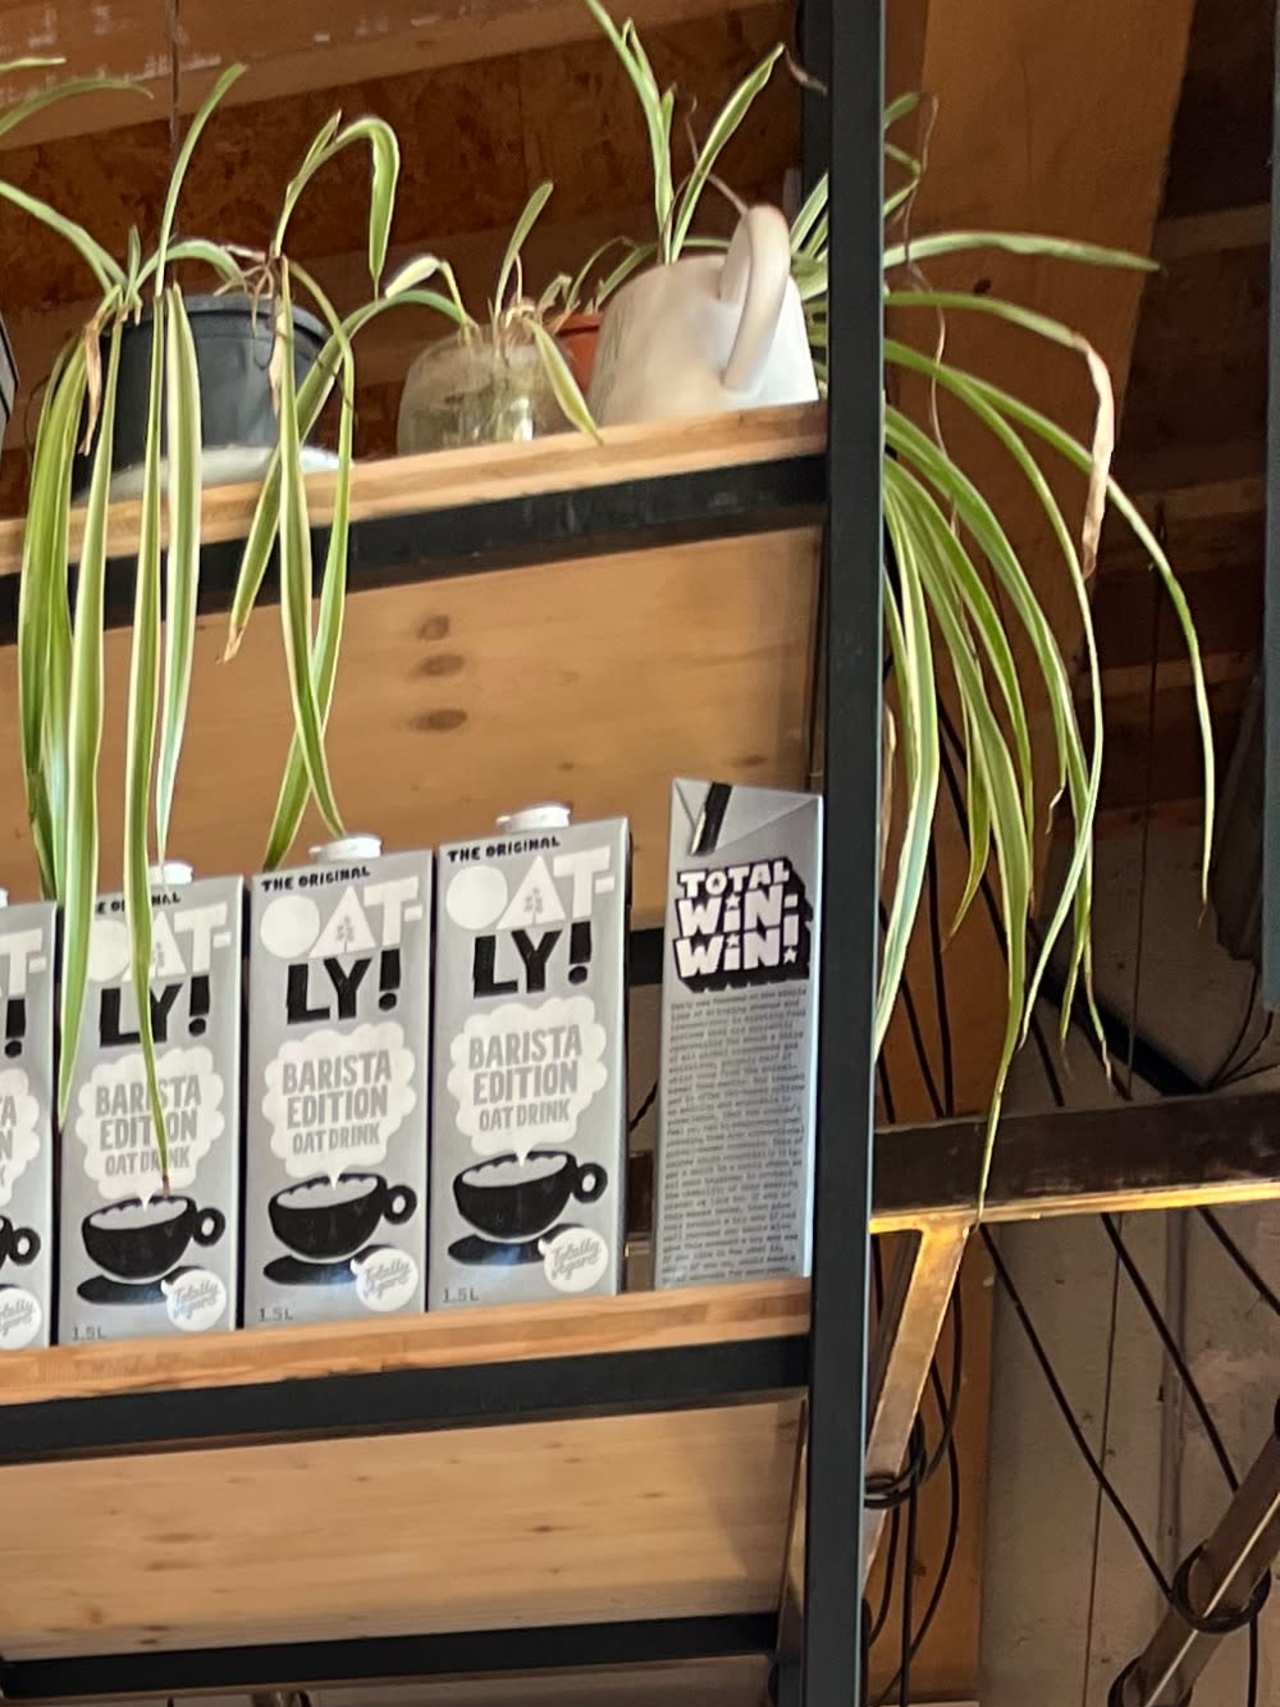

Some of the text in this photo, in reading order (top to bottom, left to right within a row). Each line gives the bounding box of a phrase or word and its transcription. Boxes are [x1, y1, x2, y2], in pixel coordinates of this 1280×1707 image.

[448, 847, 482, 865] THE
[261, 877, 292, 893] THE
[678, 859, 790, 899] TOTAL
[472, 920, 592, 999] LY!
[286, 948, 402, 1025] LY!
[99, 975, 211, 1048] LY!
[468, 1024, 583, 1070] BARISTA
[282, 1050, 393, 1095] BARISTA
[473, 1061, 579, 1106] EDITION
[287, 1085, 388, 1129] EDITION
[479, 1098, 571, 1132] OAT DRINK
[292, 1123, 380, 1155] OAT DRINK
[105, 1153, 138, 1177] OAT
